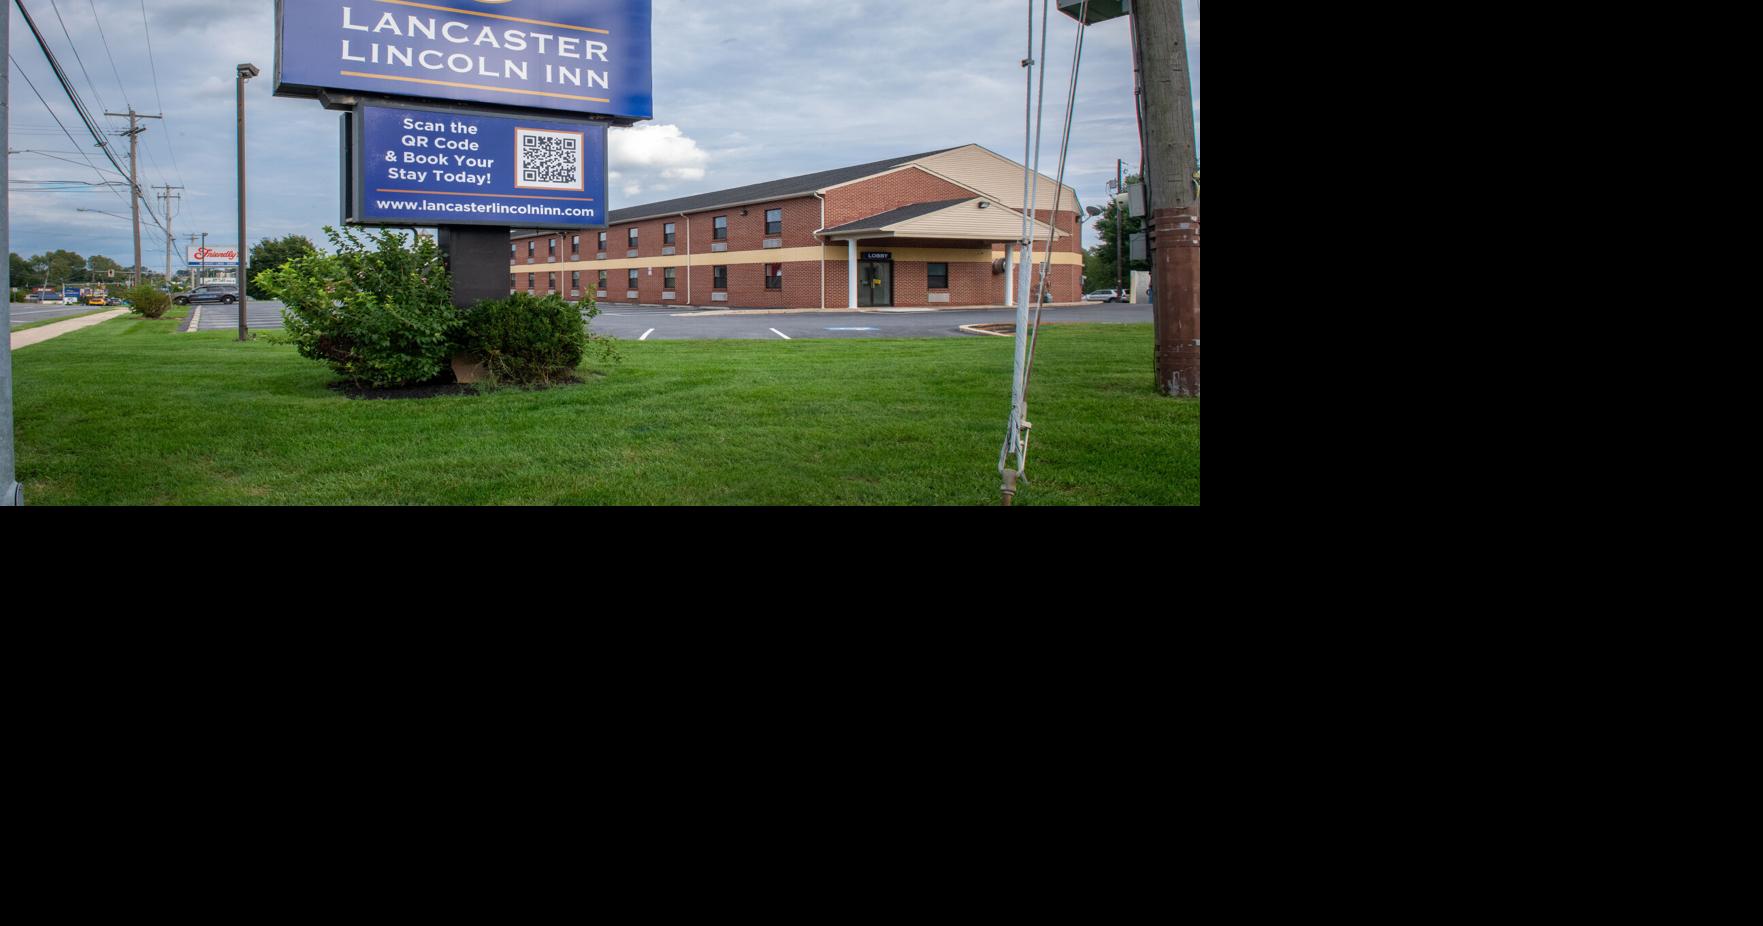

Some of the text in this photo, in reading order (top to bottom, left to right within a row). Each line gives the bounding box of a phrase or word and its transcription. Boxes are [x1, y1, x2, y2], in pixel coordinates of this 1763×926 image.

[342, 7, 609, 62] LANCASTER
[342, 40, 609, 90] LINCOLN INN
[402, 117, 478, 134] Scan the
[401, 134, 479, 151] QR Code
[384, 150, 494, 168] & Book Your
[387, 167, 491, 186] Stay Today!
[376, 200, 594, 217] www.lancasterlincolninn.com
[194, 247, 239, 260] Friendly
